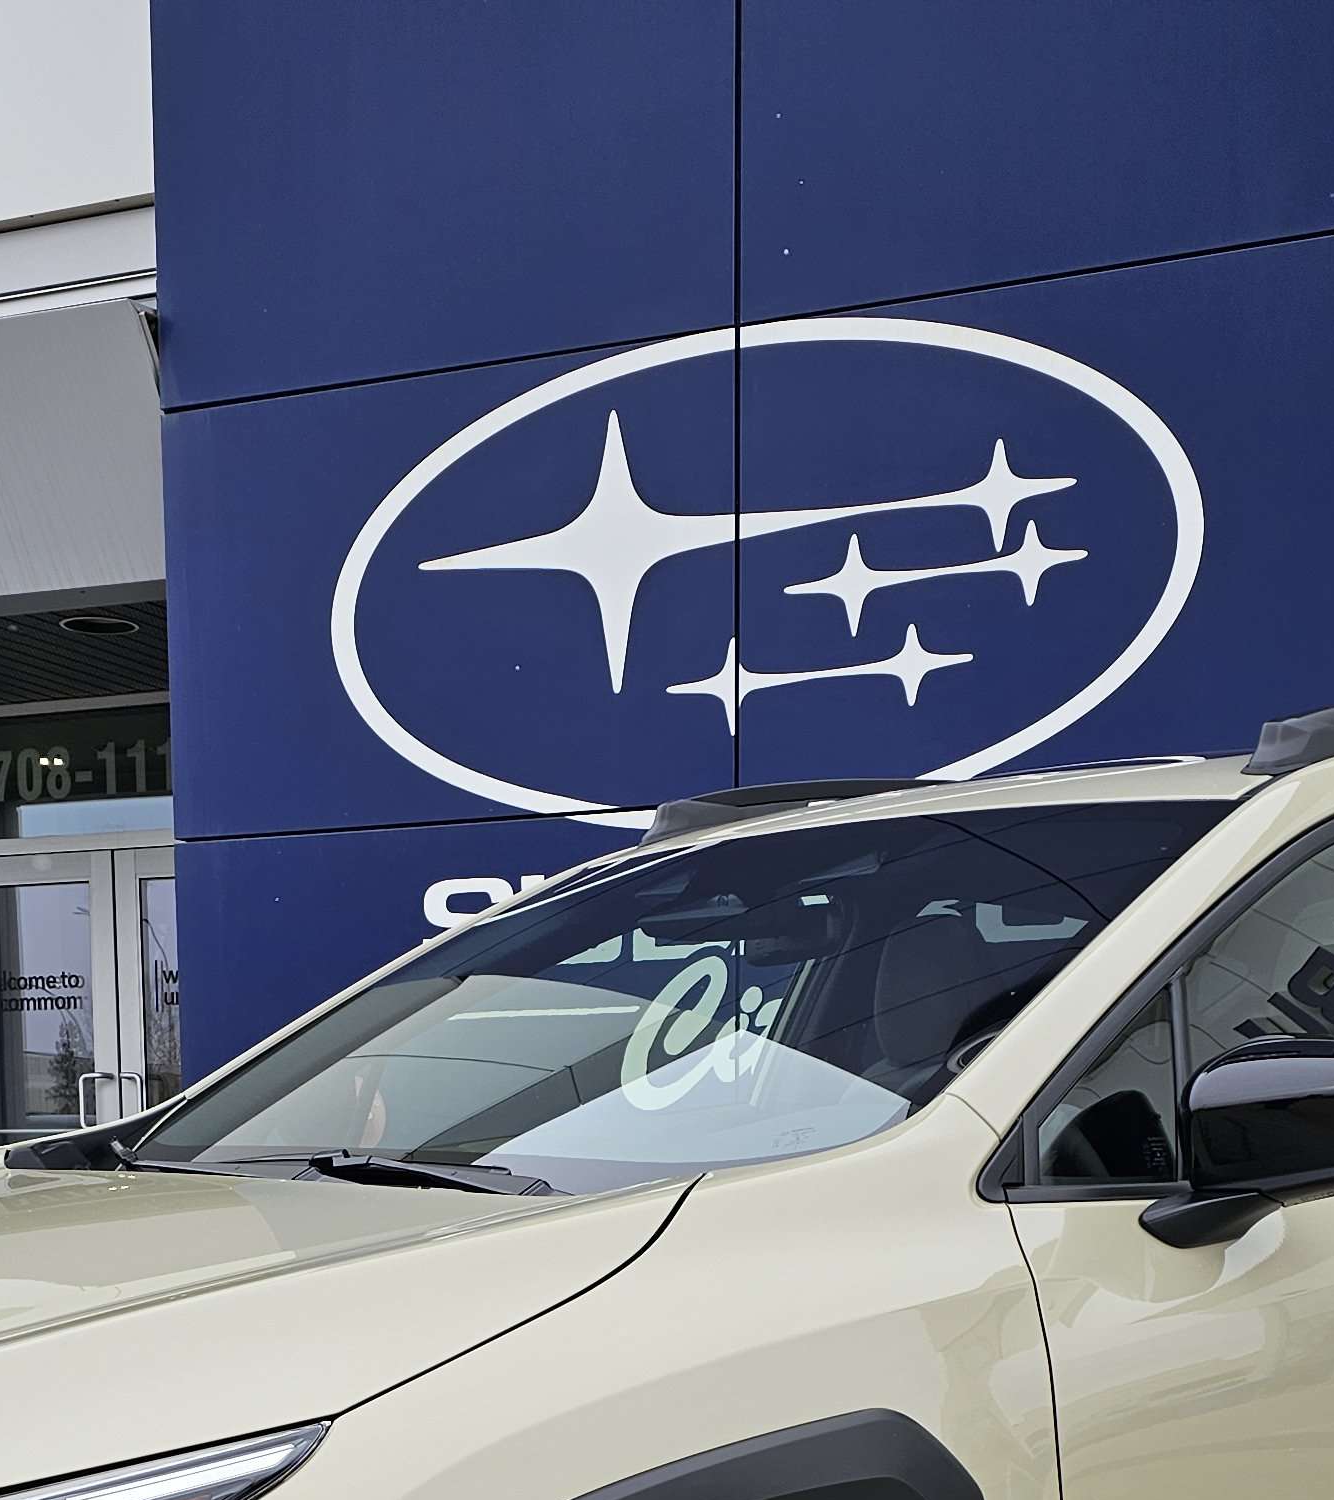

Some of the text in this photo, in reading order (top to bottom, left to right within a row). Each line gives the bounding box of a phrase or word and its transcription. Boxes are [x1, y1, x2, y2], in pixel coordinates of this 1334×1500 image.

[61, 971, 80, 989] to
[1, 995, 78, 1012] common
[621, 954, 783, 1111] Ci
